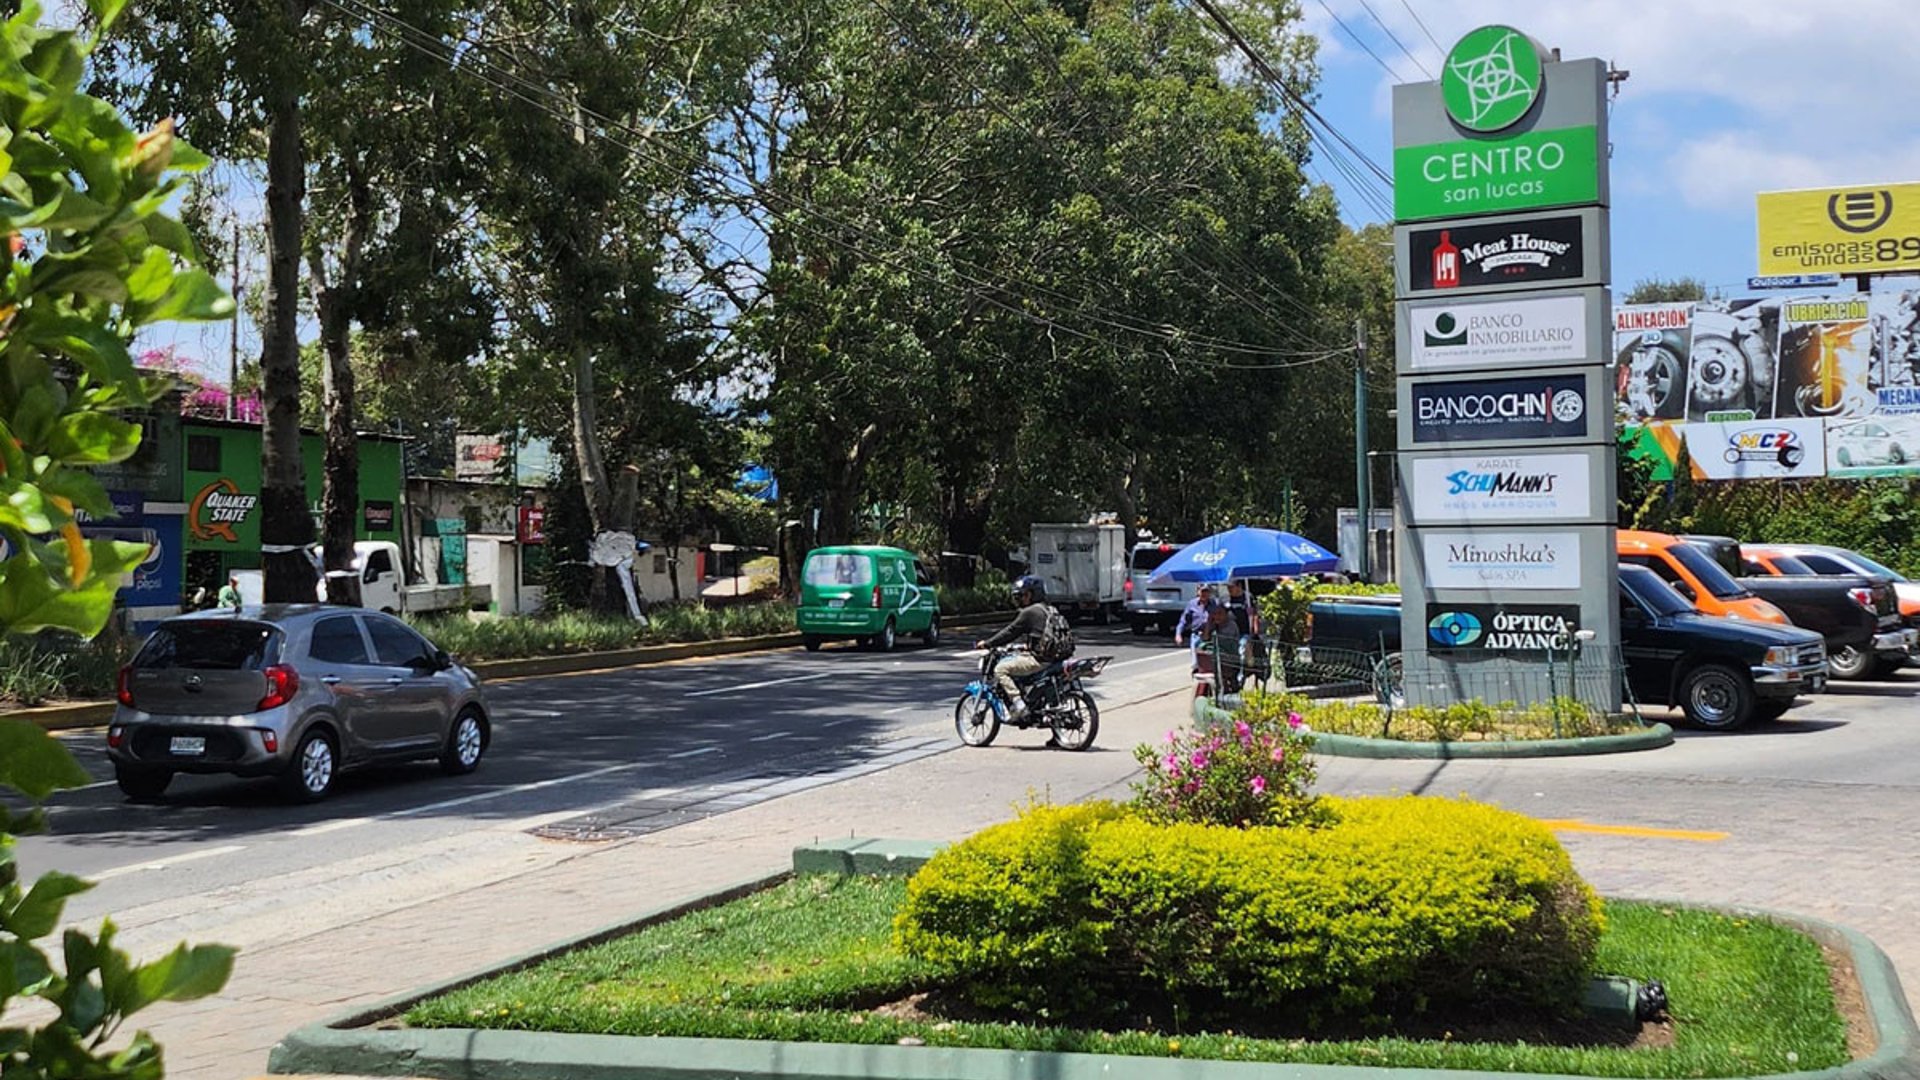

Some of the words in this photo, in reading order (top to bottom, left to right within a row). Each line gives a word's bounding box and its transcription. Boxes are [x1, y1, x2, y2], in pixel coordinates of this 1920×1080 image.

[1423, 142, 1564, 182] CENTRO
[1444, 188, 1480, 203] san
[1486, 180, 1544, 199] lucas
[1461, 239, 1508, 264] Meat
[1511, 233, 1567, 255] House
[1773, 241, 1874, 257] emisoras
[1800, 252, 1874, 267] unidas
[1470, 314, 1523, 330] BANCO
[1470, 327, 1574, 346] INMOBILIARIO
[1739, 432, 1791, 449] MCZ
[1476, 458, 1523, 470] KARATE
[206, 491, 257, 508] QUAKER
[211, 508, 248, 521] STATE
[1448, 543, 1556, 564] Minoshka's
[1493, 611, 1569, 633] ÓPTICA
